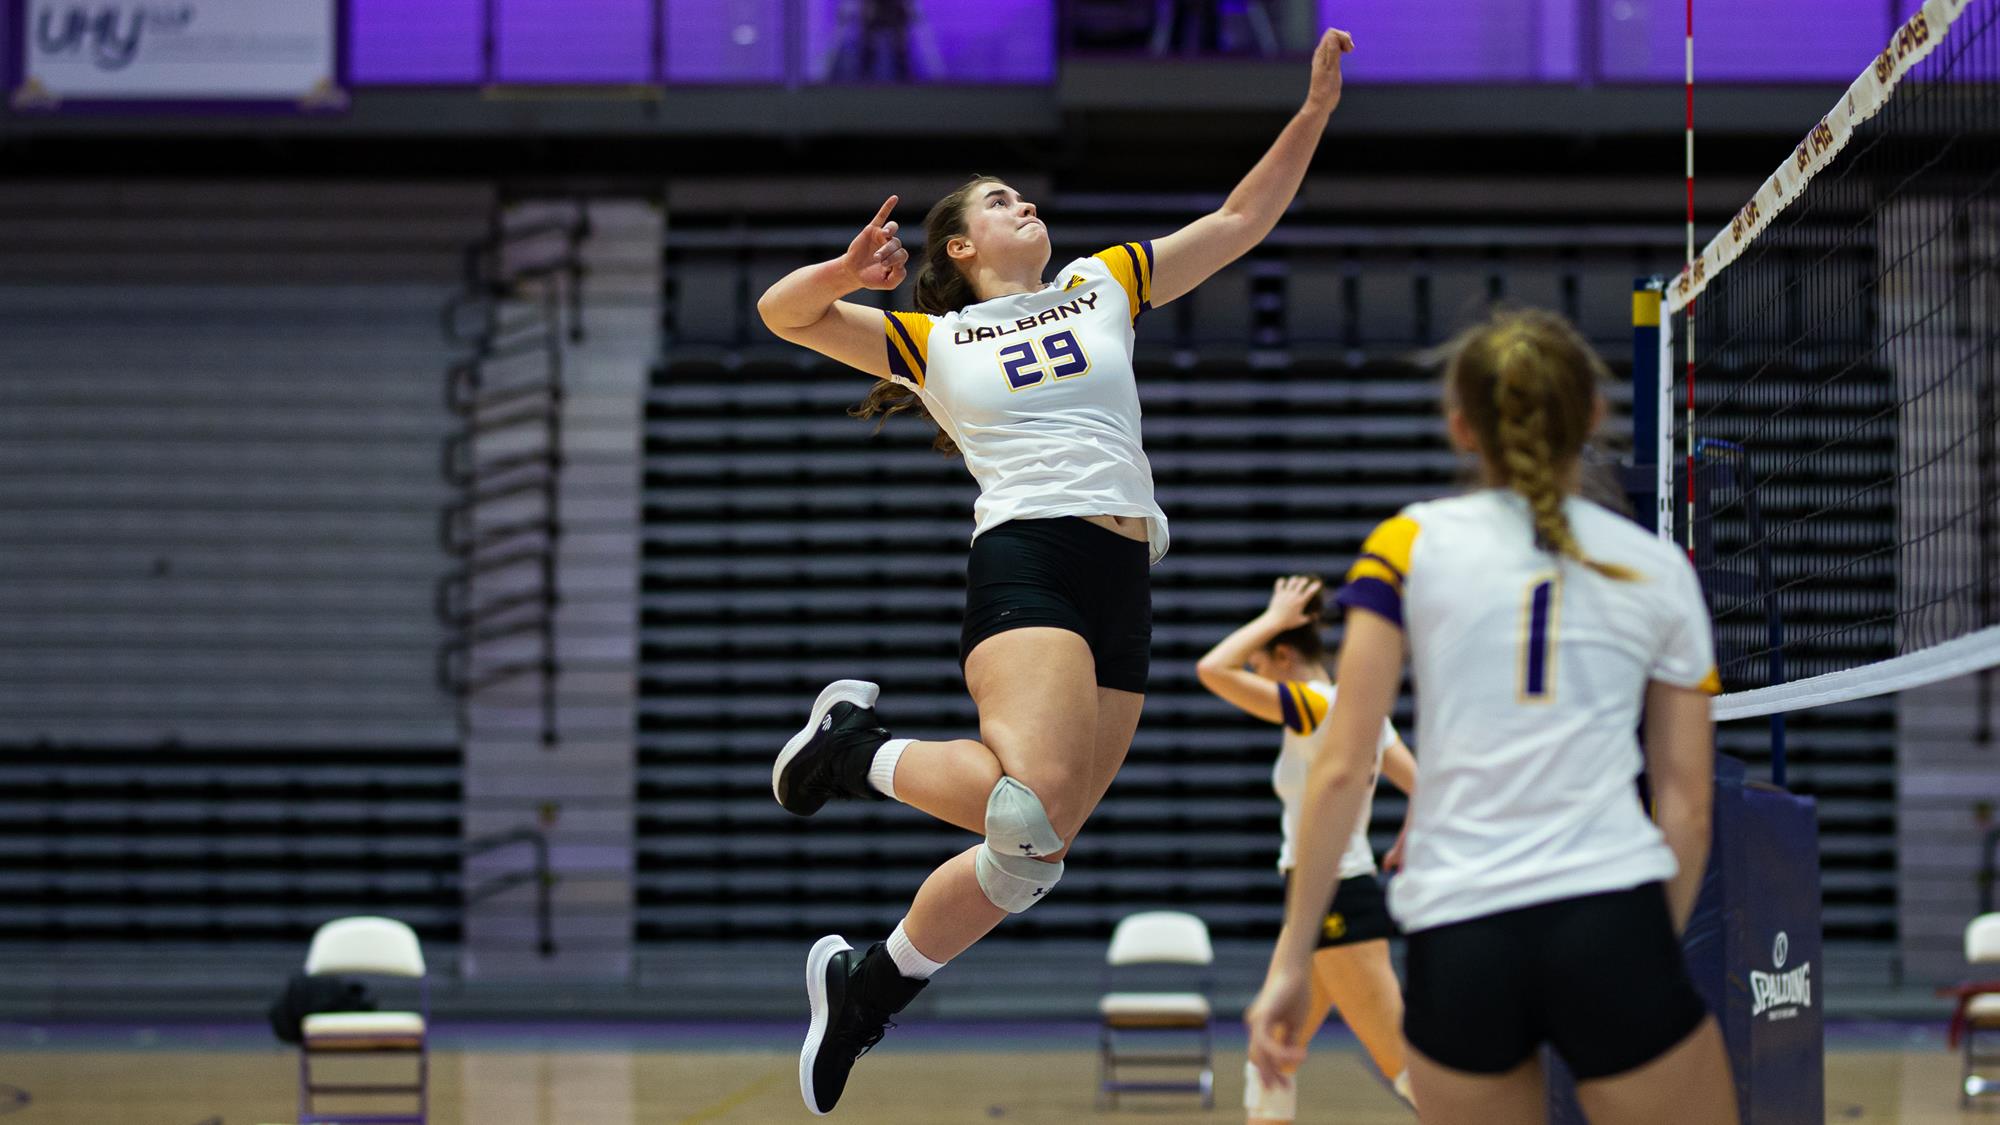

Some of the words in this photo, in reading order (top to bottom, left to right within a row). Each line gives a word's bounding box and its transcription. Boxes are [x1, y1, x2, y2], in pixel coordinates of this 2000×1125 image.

[954, 291, 1098, 345] UALBANY
[997, 328, 1091, 392] 29
[1520, 575, 1558, 699] 1
[1750, 961, 1811, 1016] SPALDING
